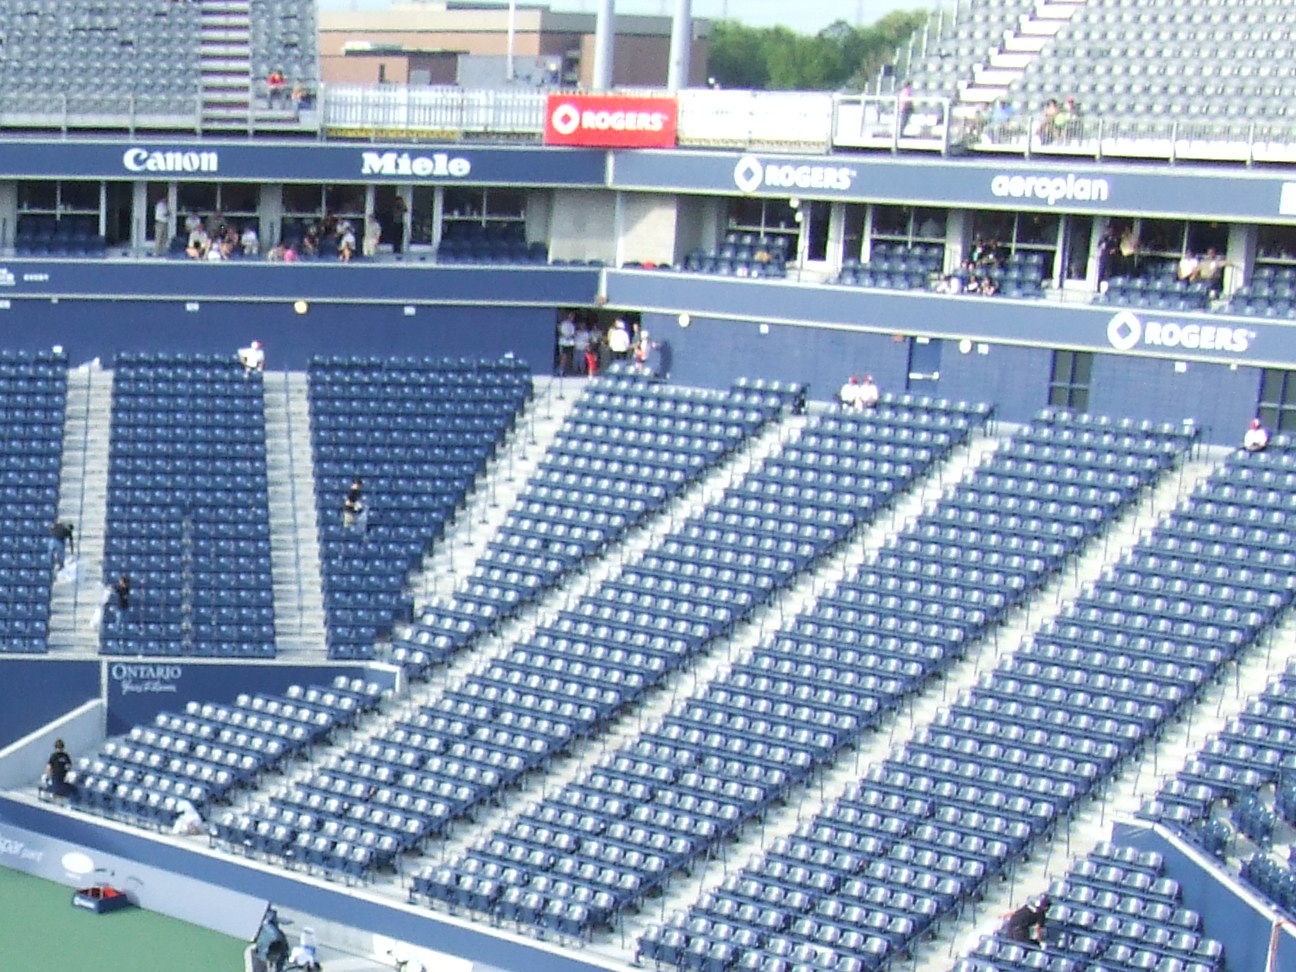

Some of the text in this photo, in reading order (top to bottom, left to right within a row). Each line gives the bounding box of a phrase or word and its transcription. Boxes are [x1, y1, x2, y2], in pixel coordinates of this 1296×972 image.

[581, 110, 664, 132] ROGERS
[123, 147, 218, 172] Canon
[361, 152, 472, 177] Miele
[764, 164, 852, 191] ROGERS
[990, 173, 1108, 206] aeroplan
[1144, 321, 1249, 352] ROGERS
